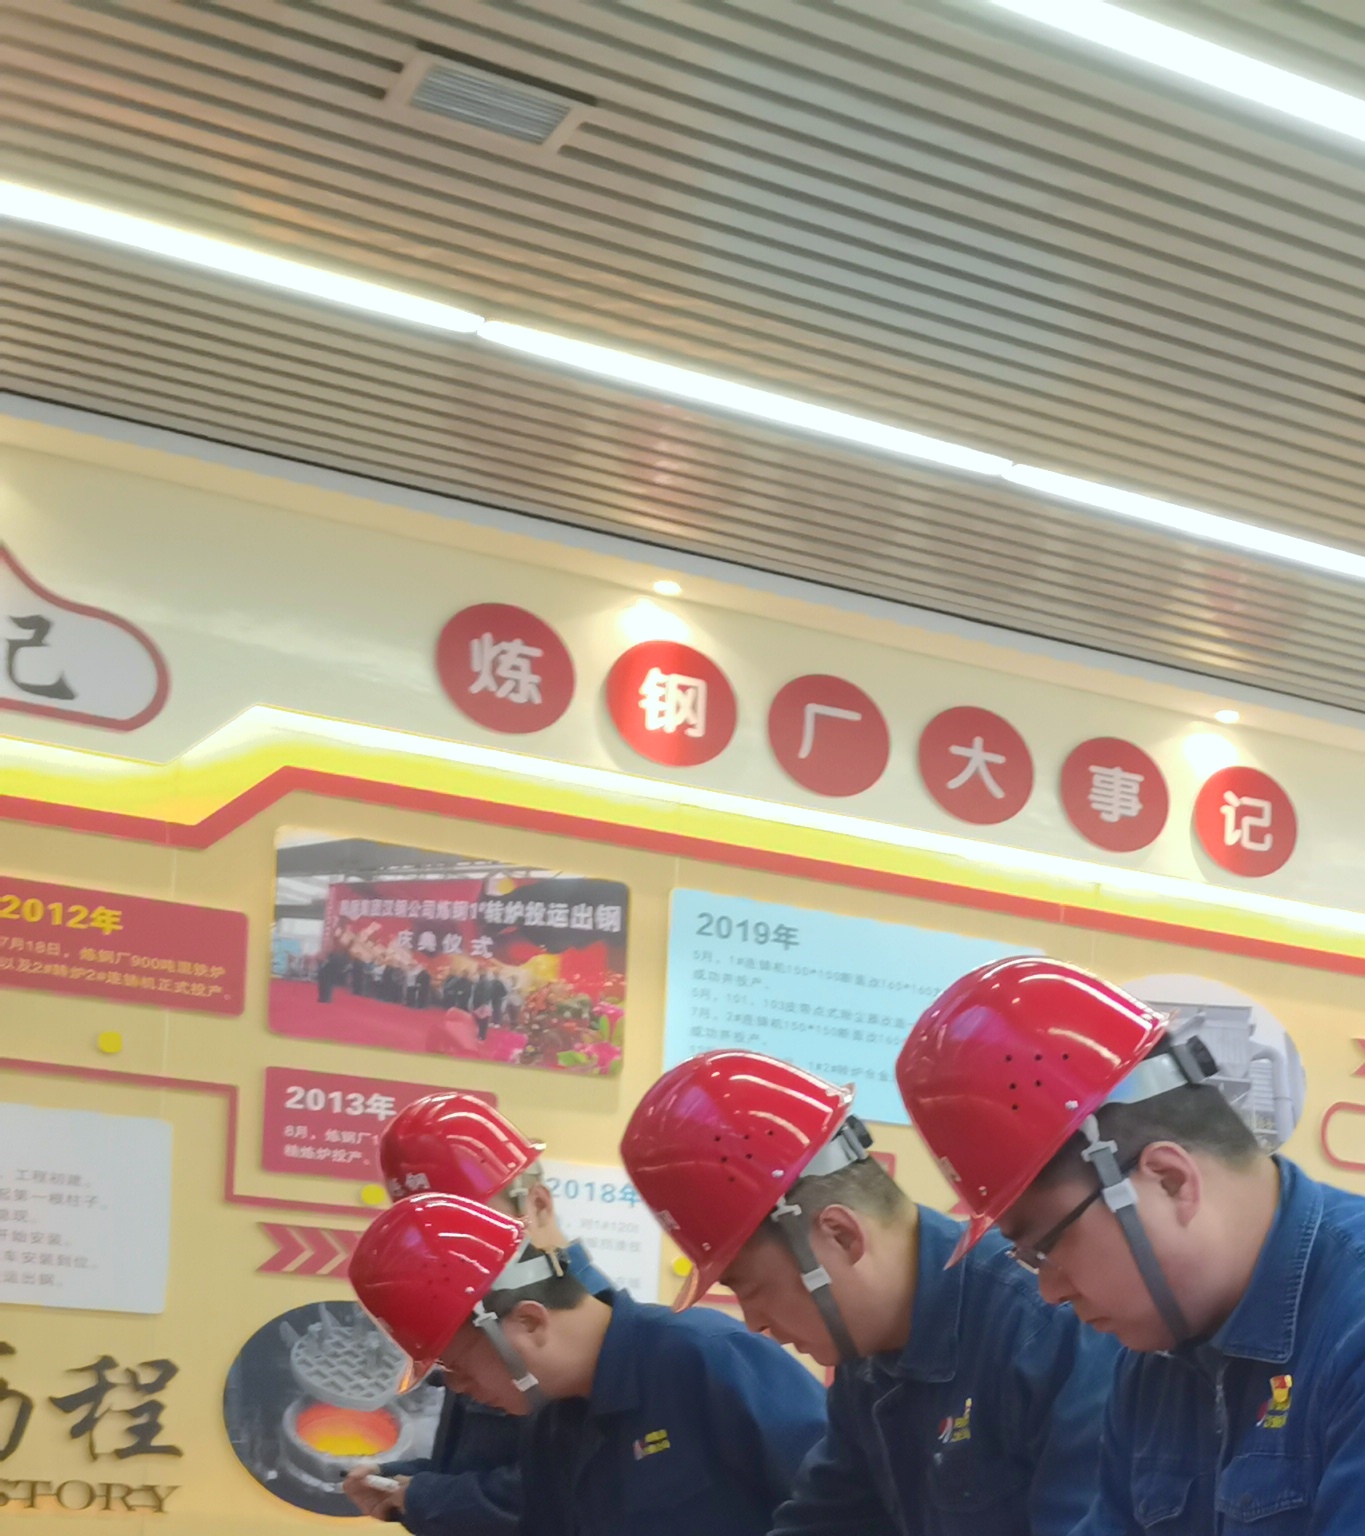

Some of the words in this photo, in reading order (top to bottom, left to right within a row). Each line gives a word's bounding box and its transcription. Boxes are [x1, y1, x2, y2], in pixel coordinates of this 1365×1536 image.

[469, 631, 1273, 852] 炼钢厂大事记
[0, 894, 123, 935] 2012年
[696, 912, 800, 950] 2019年
[284, 1085, 397, 1121] 2013年
